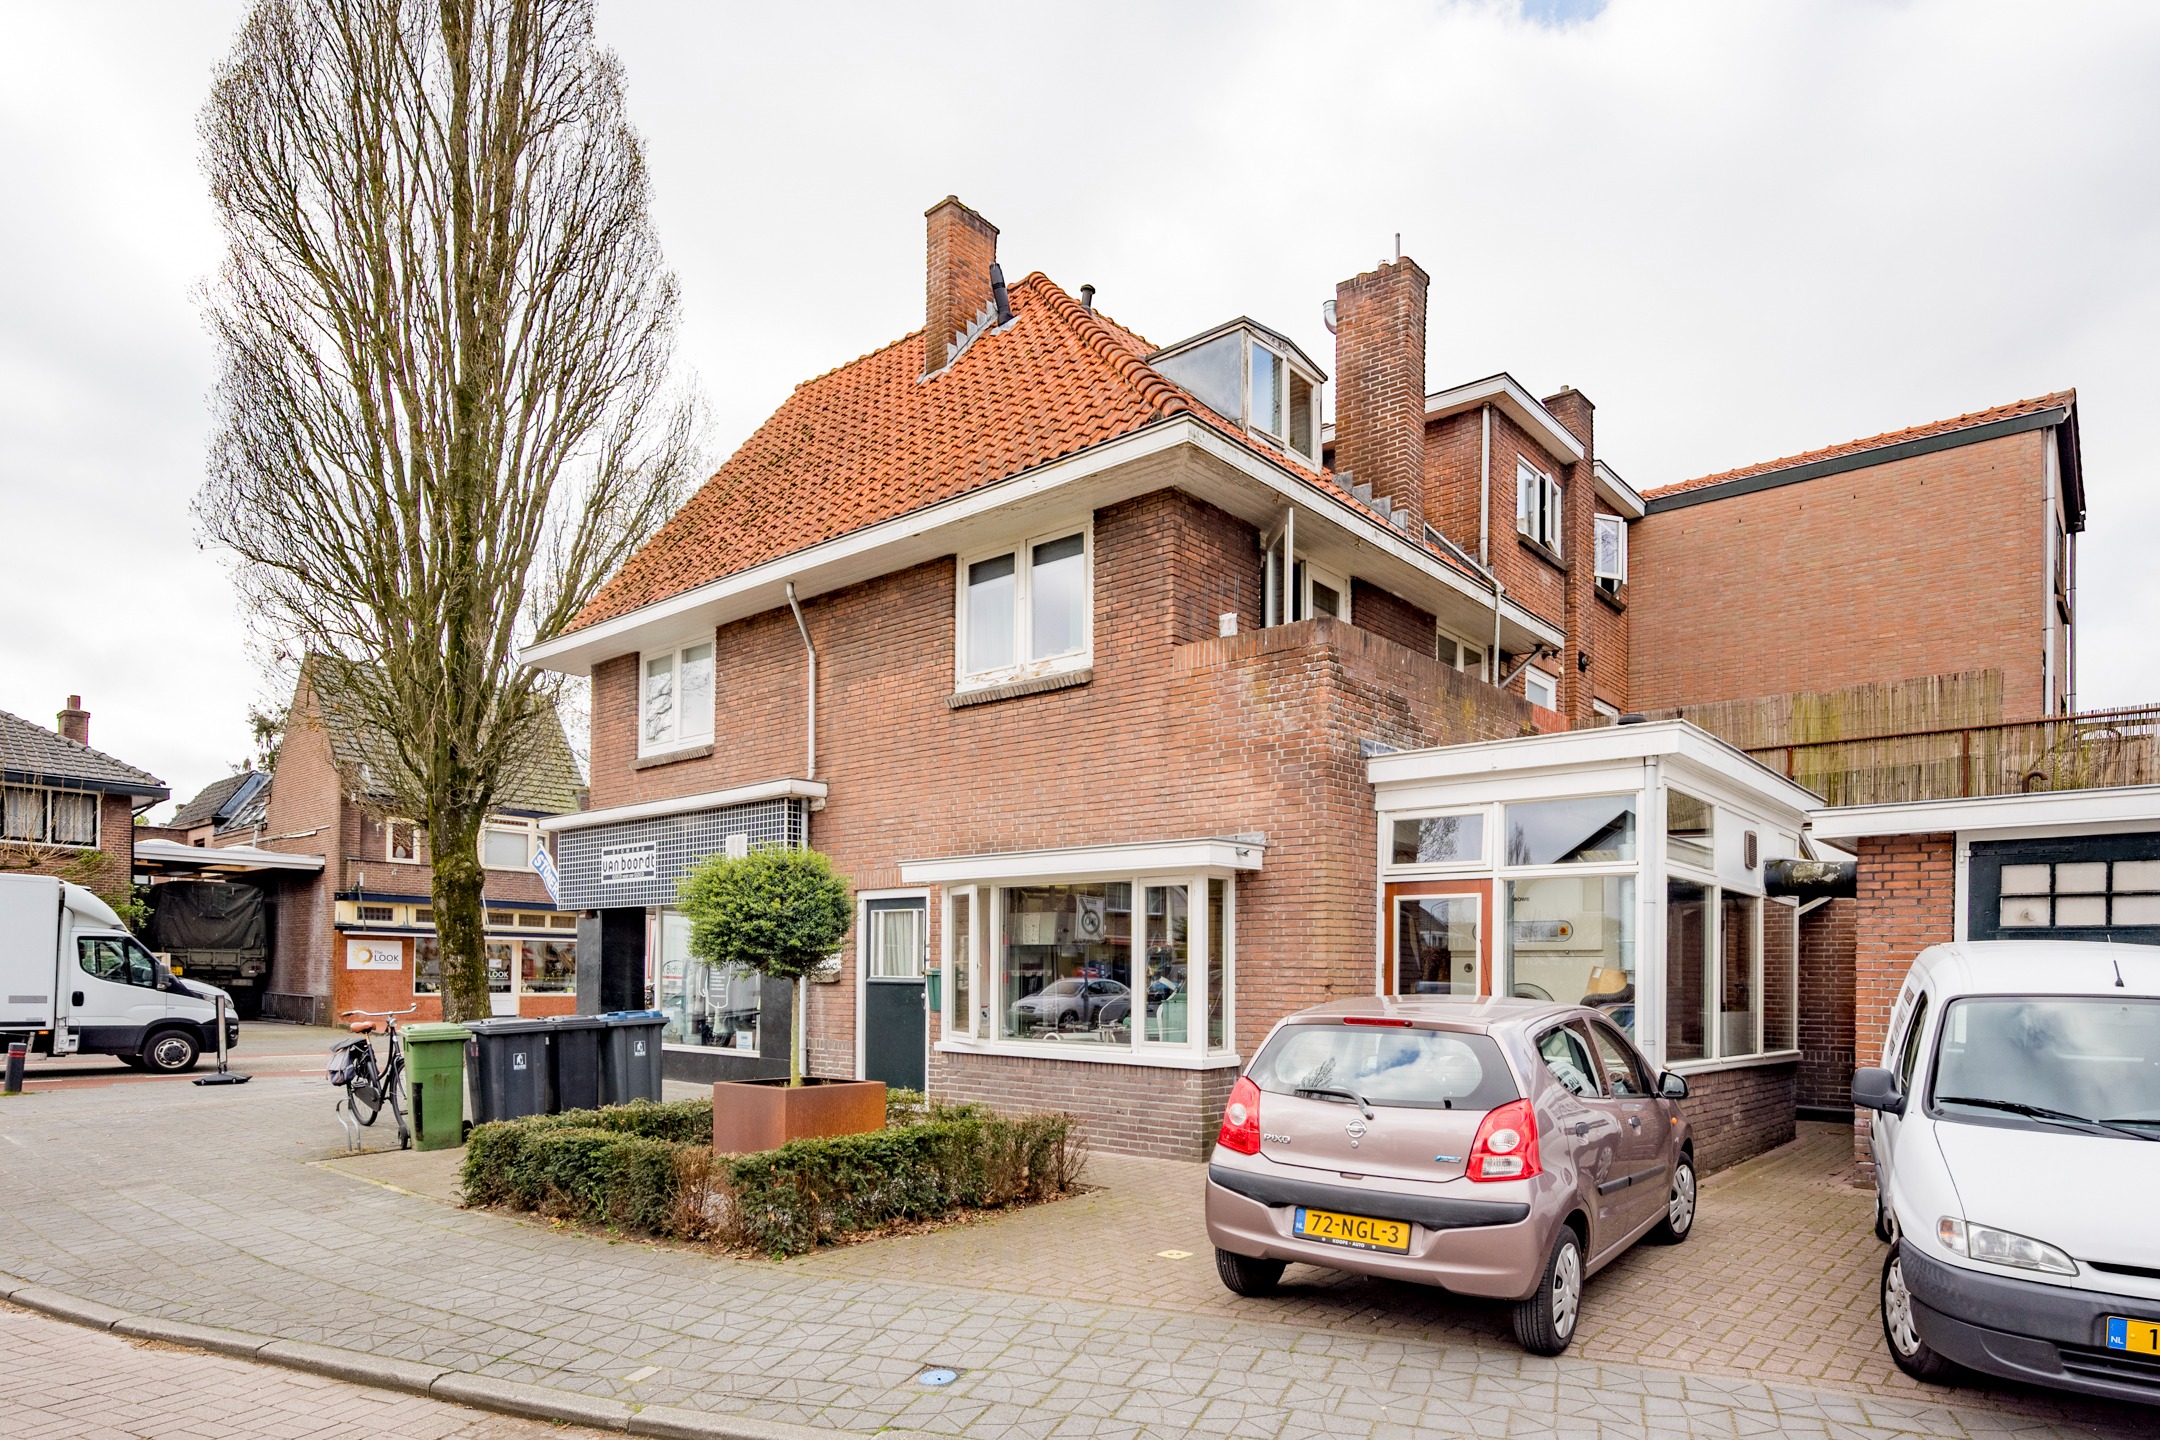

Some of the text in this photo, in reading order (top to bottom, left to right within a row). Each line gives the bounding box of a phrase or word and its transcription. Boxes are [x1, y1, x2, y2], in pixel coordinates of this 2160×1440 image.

[621, 853, 655, 870] boordt
[374, 954, 399, 962] LOOK
[1263, 1132, 1292, 1145] PIXO
[1295, 1213, 1400, 1244] NL 72-NGL-3
[1351, 1241, 1365, 1249] AUTO
[2110, 1335, 2125, 1345] NL
